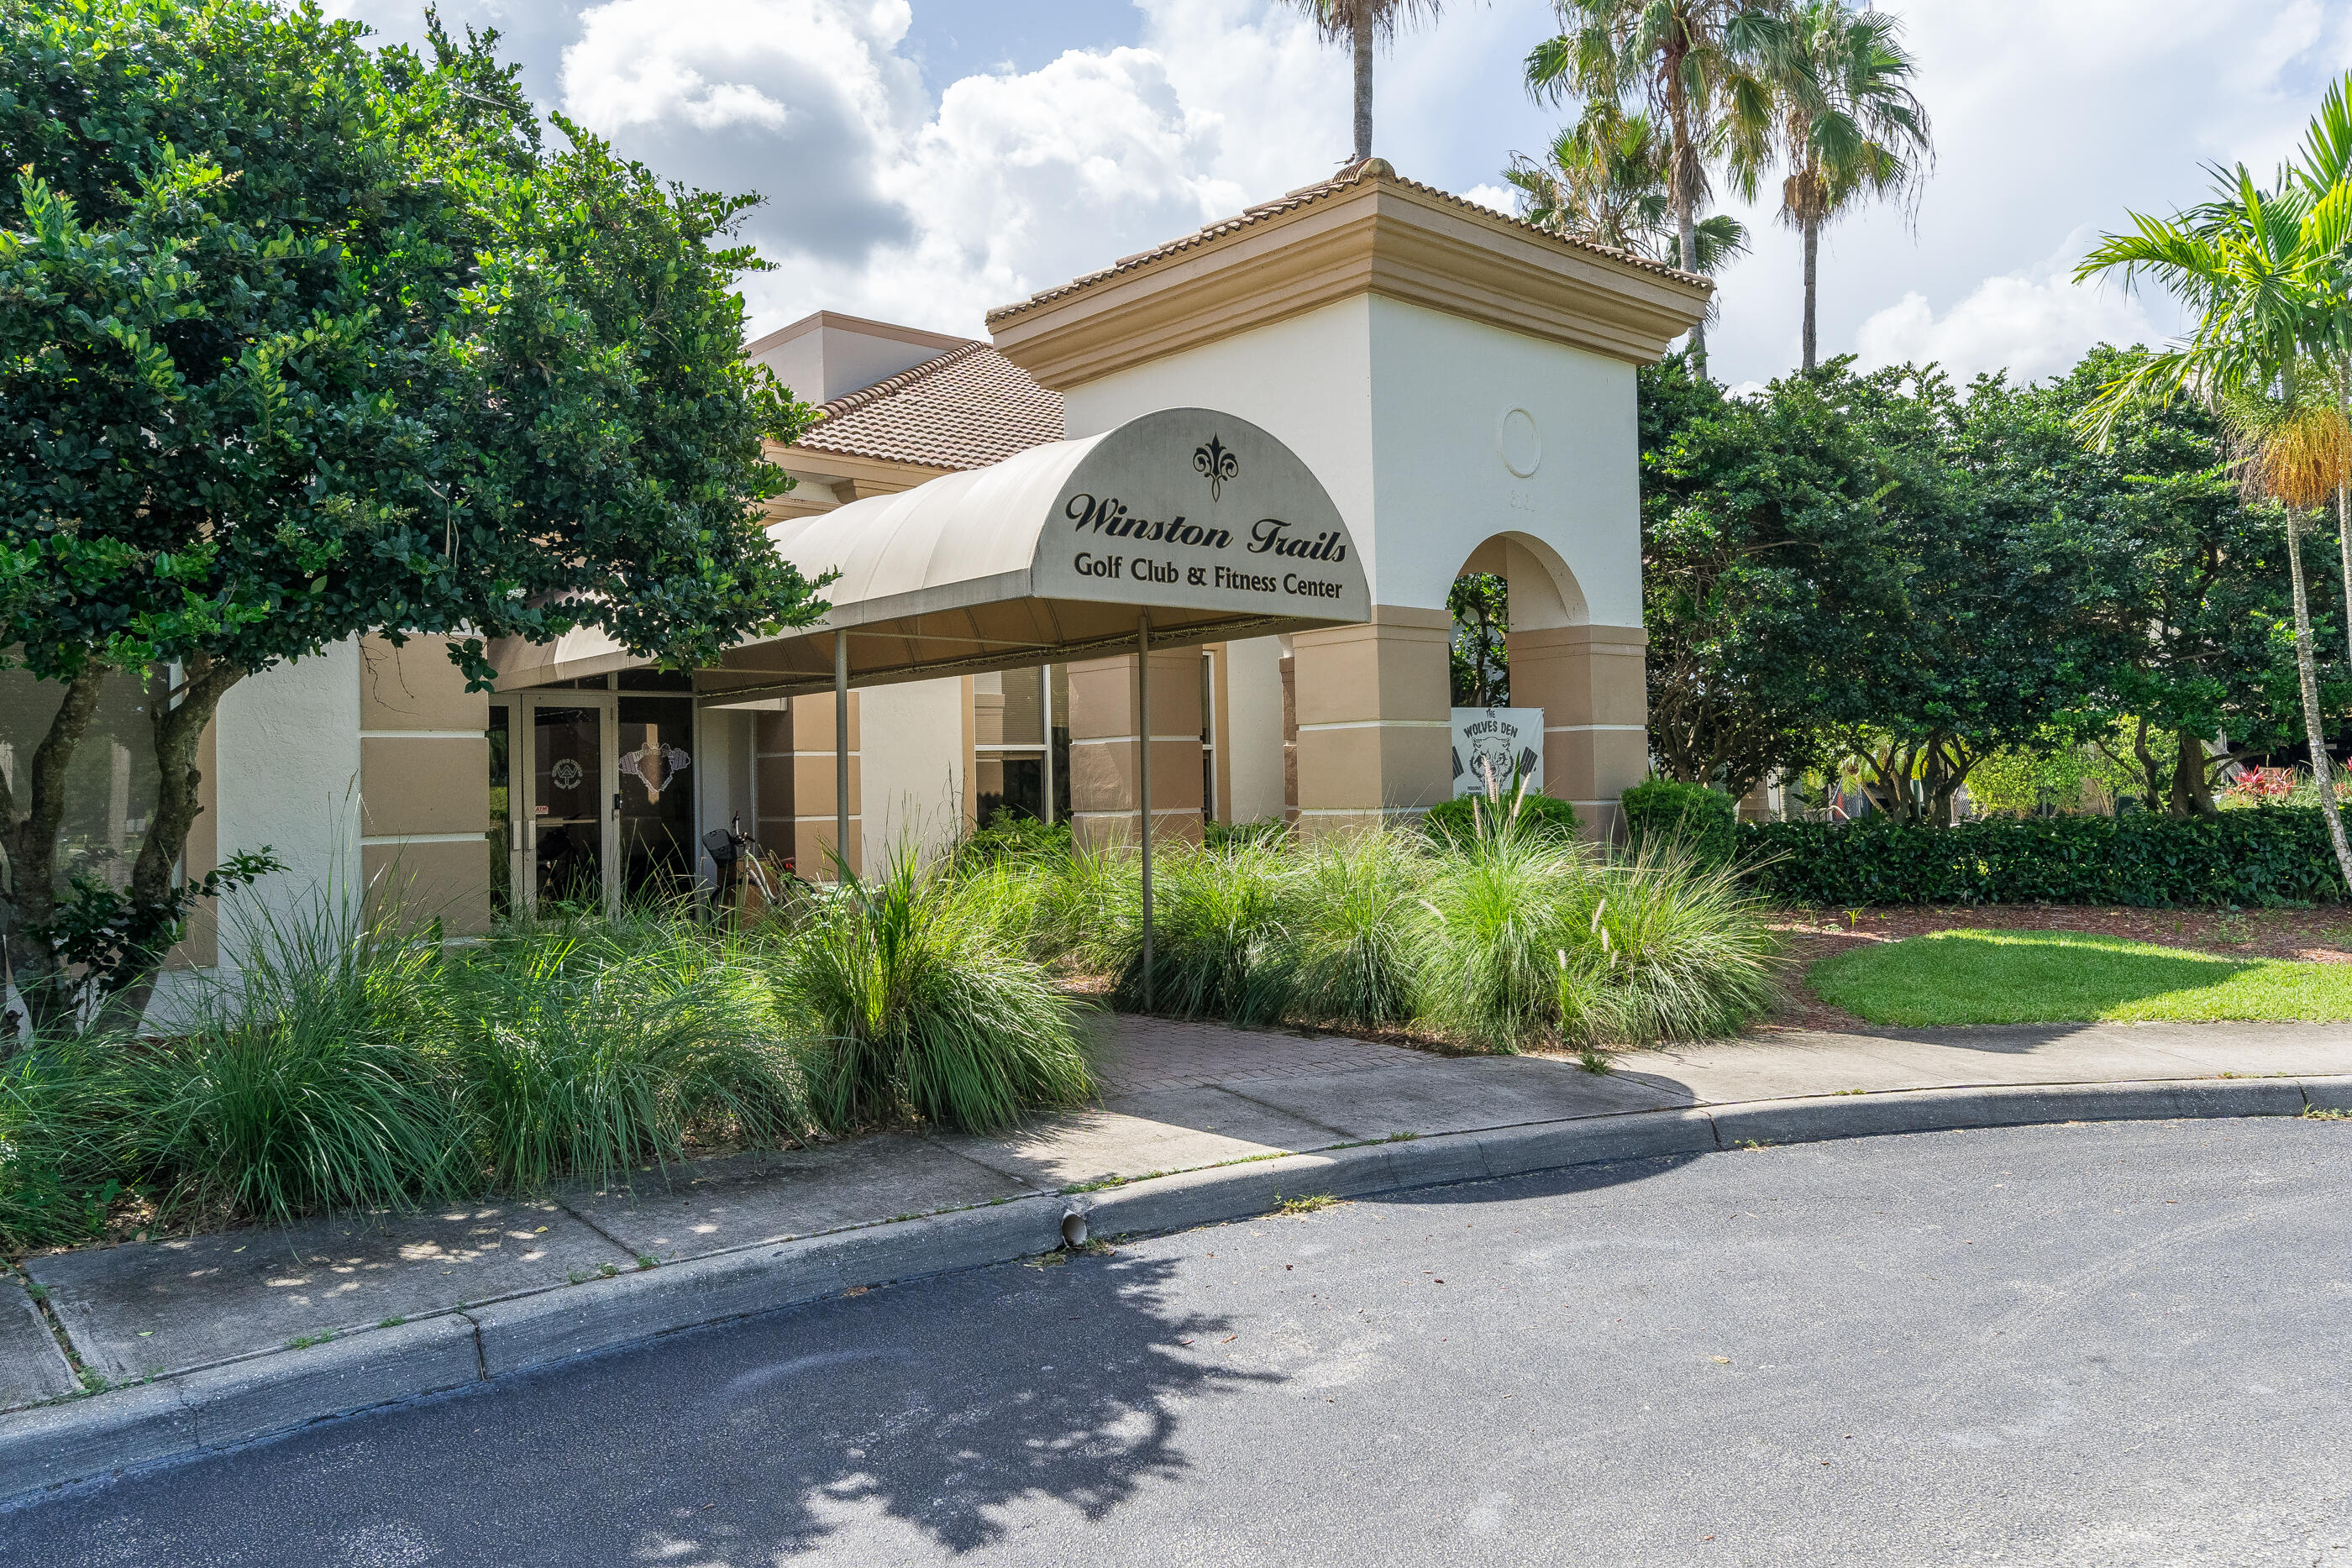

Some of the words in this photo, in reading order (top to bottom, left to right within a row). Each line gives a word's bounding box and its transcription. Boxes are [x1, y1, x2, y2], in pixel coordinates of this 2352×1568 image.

[1065, 493, 1234, 549] Winston
[1247, 517, 1347, 563] Trails
[1074, 551, 1122, 579] Golf
[1131, 558, 1179, 584] Club
[1187, 567, 1208, 587] &
[1215, 566, 1278, 594] Fitness
[1283, 573, 1343, 599] Center
[1463, 721, 1498, 738] WOLVES
[1500, 721, 1519, 738] DEN
[1486, 708, 1496, 719] THE
